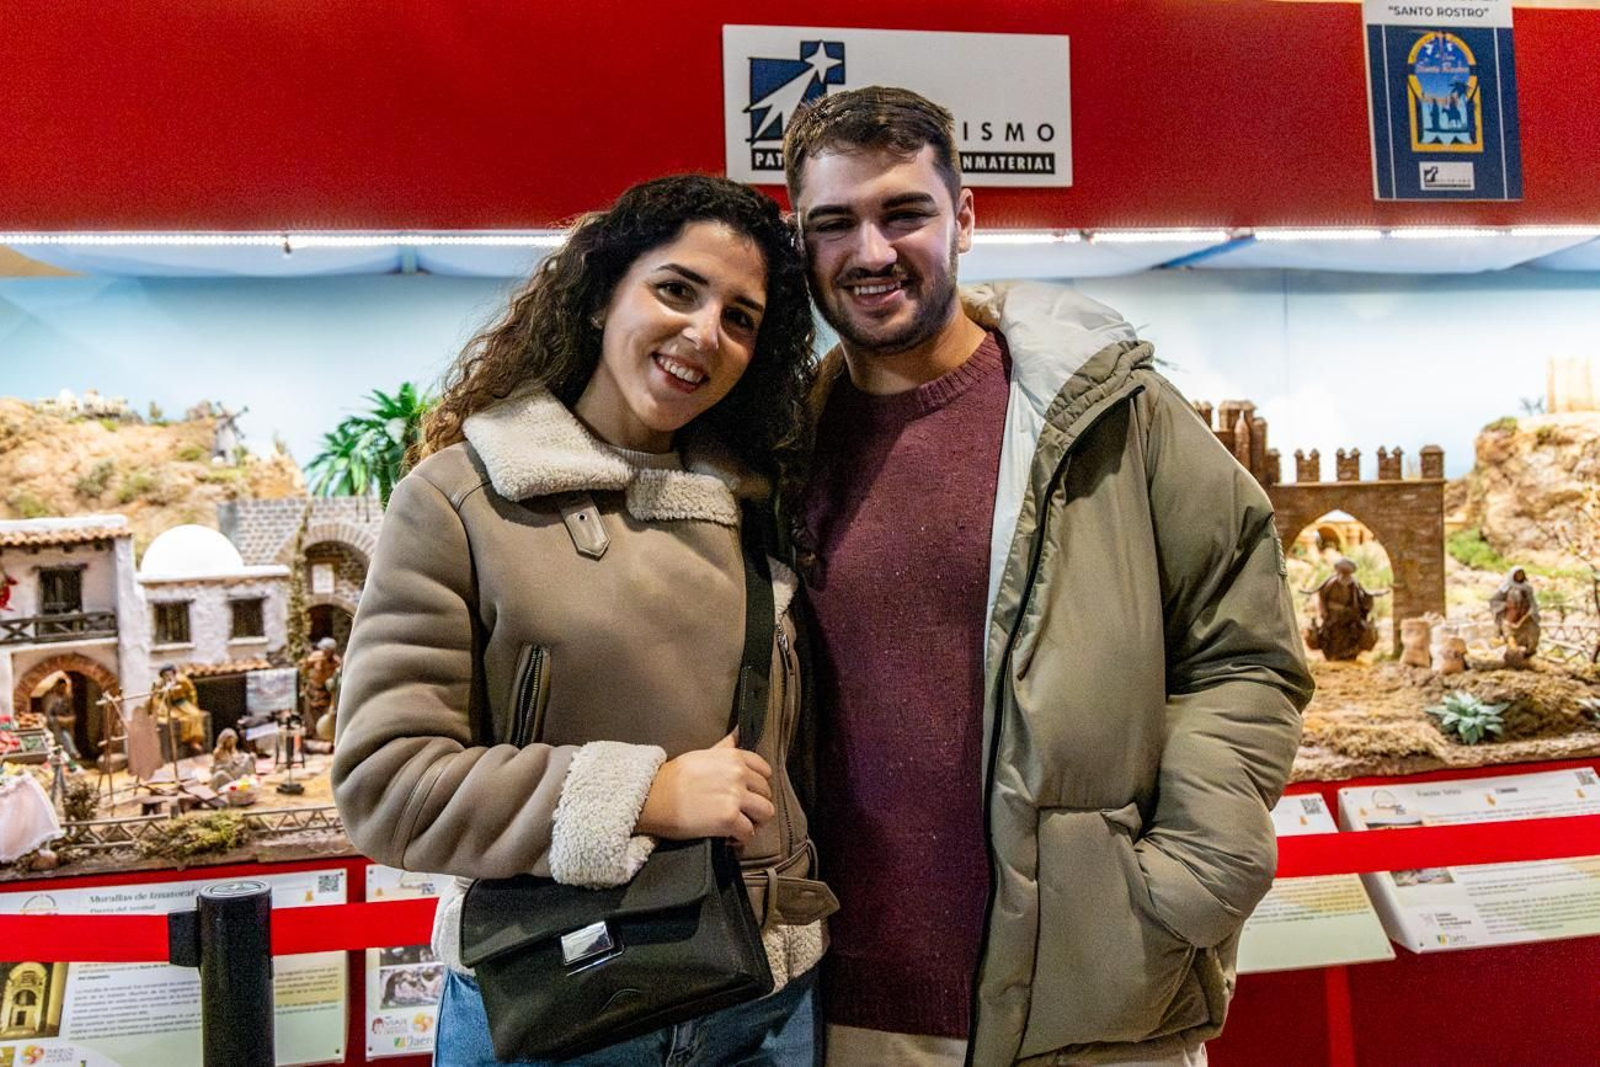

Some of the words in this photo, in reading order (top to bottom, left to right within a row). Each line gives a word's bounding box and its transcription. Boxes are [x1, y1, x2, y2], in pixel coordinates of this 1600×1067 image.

[963, 121, 1055, 142] ISMO
[755, 152, 783, 167] PAT
[961, 155, 1052, 171] NMATERIAL
